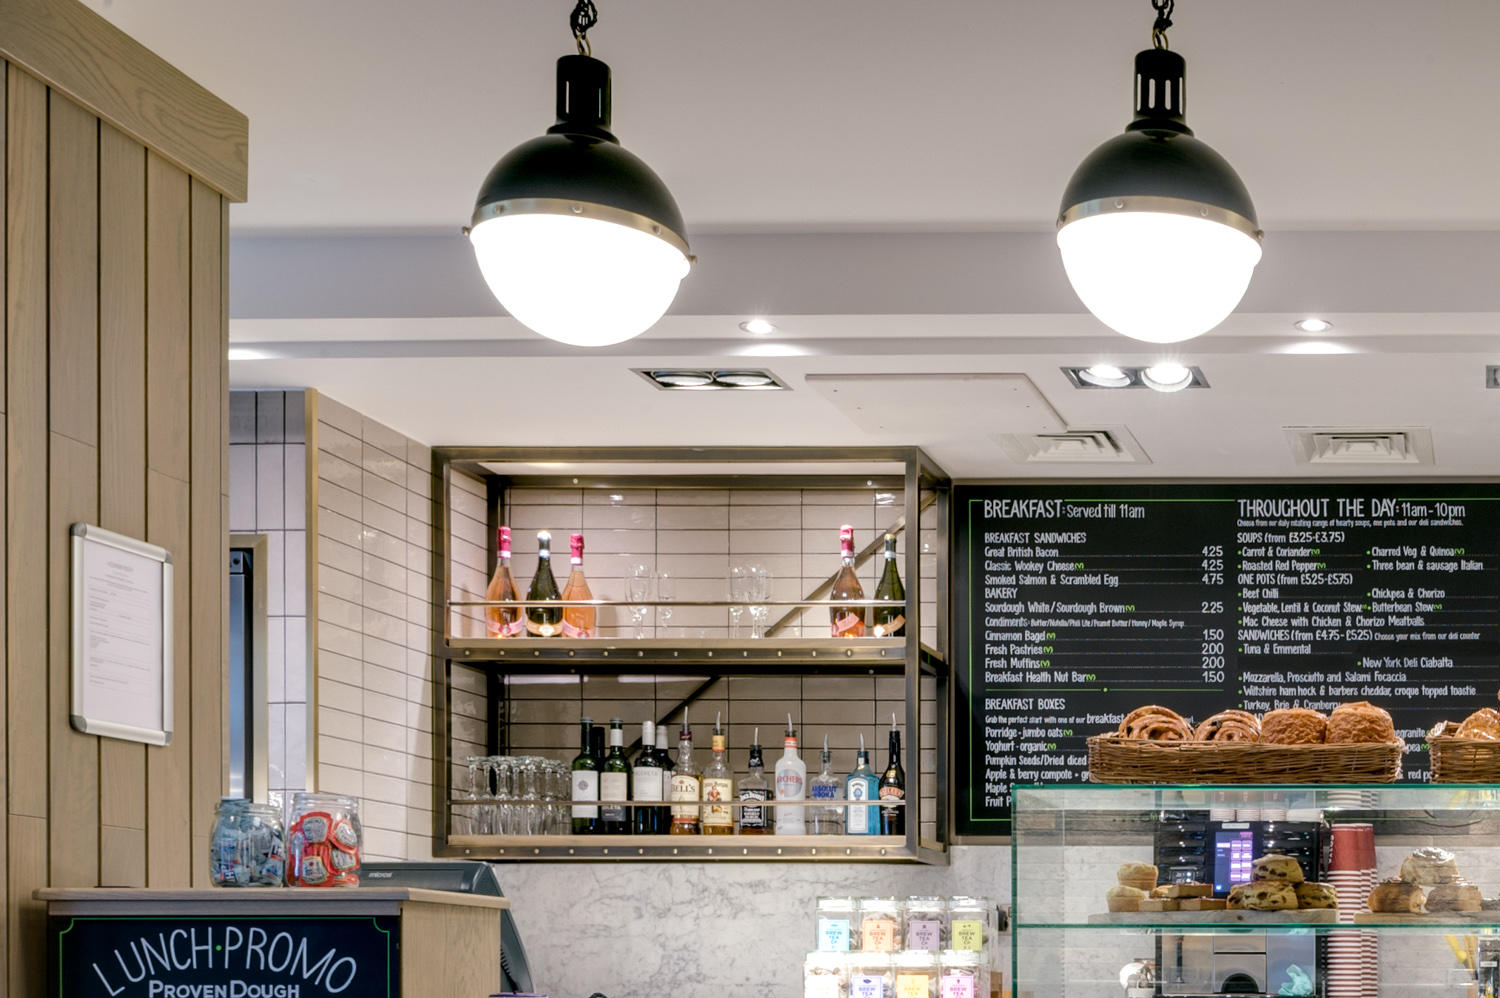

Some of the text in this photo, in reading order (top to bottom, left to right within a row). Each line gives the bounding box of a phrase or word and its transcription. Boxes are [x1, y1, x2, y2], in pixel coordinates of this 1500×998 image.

[1067, 505, 1101, 518] Served
[1103, 505, 1116, 518] till
[1119, 505, 1145, 518] 11am
[1238, 499, 1329, 517] THROUGHOUT
[1337, 499, 1364, 517] THE
[985, 533, 1086, 543] BREAKFAST SANDWICHES
[1237, 532, 1262, 543] SOUPS
[985, 547, 1059, 557] Great British Bacon
[1242, 547, 1265, 557] Carrot
[1372, 547, 1400, 558] Charred
[985, 561, 1044, 573] Classic Wookey
[1242, 561, 1289, 572] Roasted Red
[1372, 561, 1414, 572] Three bean
[985, 574, 1016, 586] Smoked
[1019, 574, 1047, 586] Salmon
[1060, 574, 1101, 584] Scrambled
[1238, 574, 1254, 585] ONE
[1256, 574, 1275, 585] POTS
[985, 588, 1017, 598] BAKERY
[1243, 588, 1259, 598] Beef
[1372, 588, 1445, 600] Chickpea Chorizo
[985, 602, 1024, 614] Sourdough
[1313, 602, 1340, 612] Coconut
[1243, 616, 1424, 626] Mac Cheese with Chicken Chorizo Meatballs
[985, 630, 1022, 641] Cinnamon
[1238, 630, 1289, 641] SANDWICHES
[985, 644, 1007, 655] Fresh
[1244, 644, 1311, 654] Tuna Emmental
[985, 658, 1007, 668] Fresh
[1363, 657, 1453, 668] New York Deli Ciabatta
[985, 672, 1023, 682] Breakfast
[1026, 672, 1051, 682] Health
[1054, 672, 1068, 682] Nut
[1288, 672, 1406, 683] Prosciutto and Salami Focaccia
[1244, 685, 1476, 697] Wiltshire barbers topped toastie
[985, 699, 1065, 710] BREAKFAST BOXES
[986, 755, 1016, 767] Pumpkin
[986, 769, 1072, 781] Apple berry compote
[986, 783, 1008, 794] Maple
[986, 797, 1004, 807] Fruit
[92, 926, 357, 997] LUNCH PROMO
